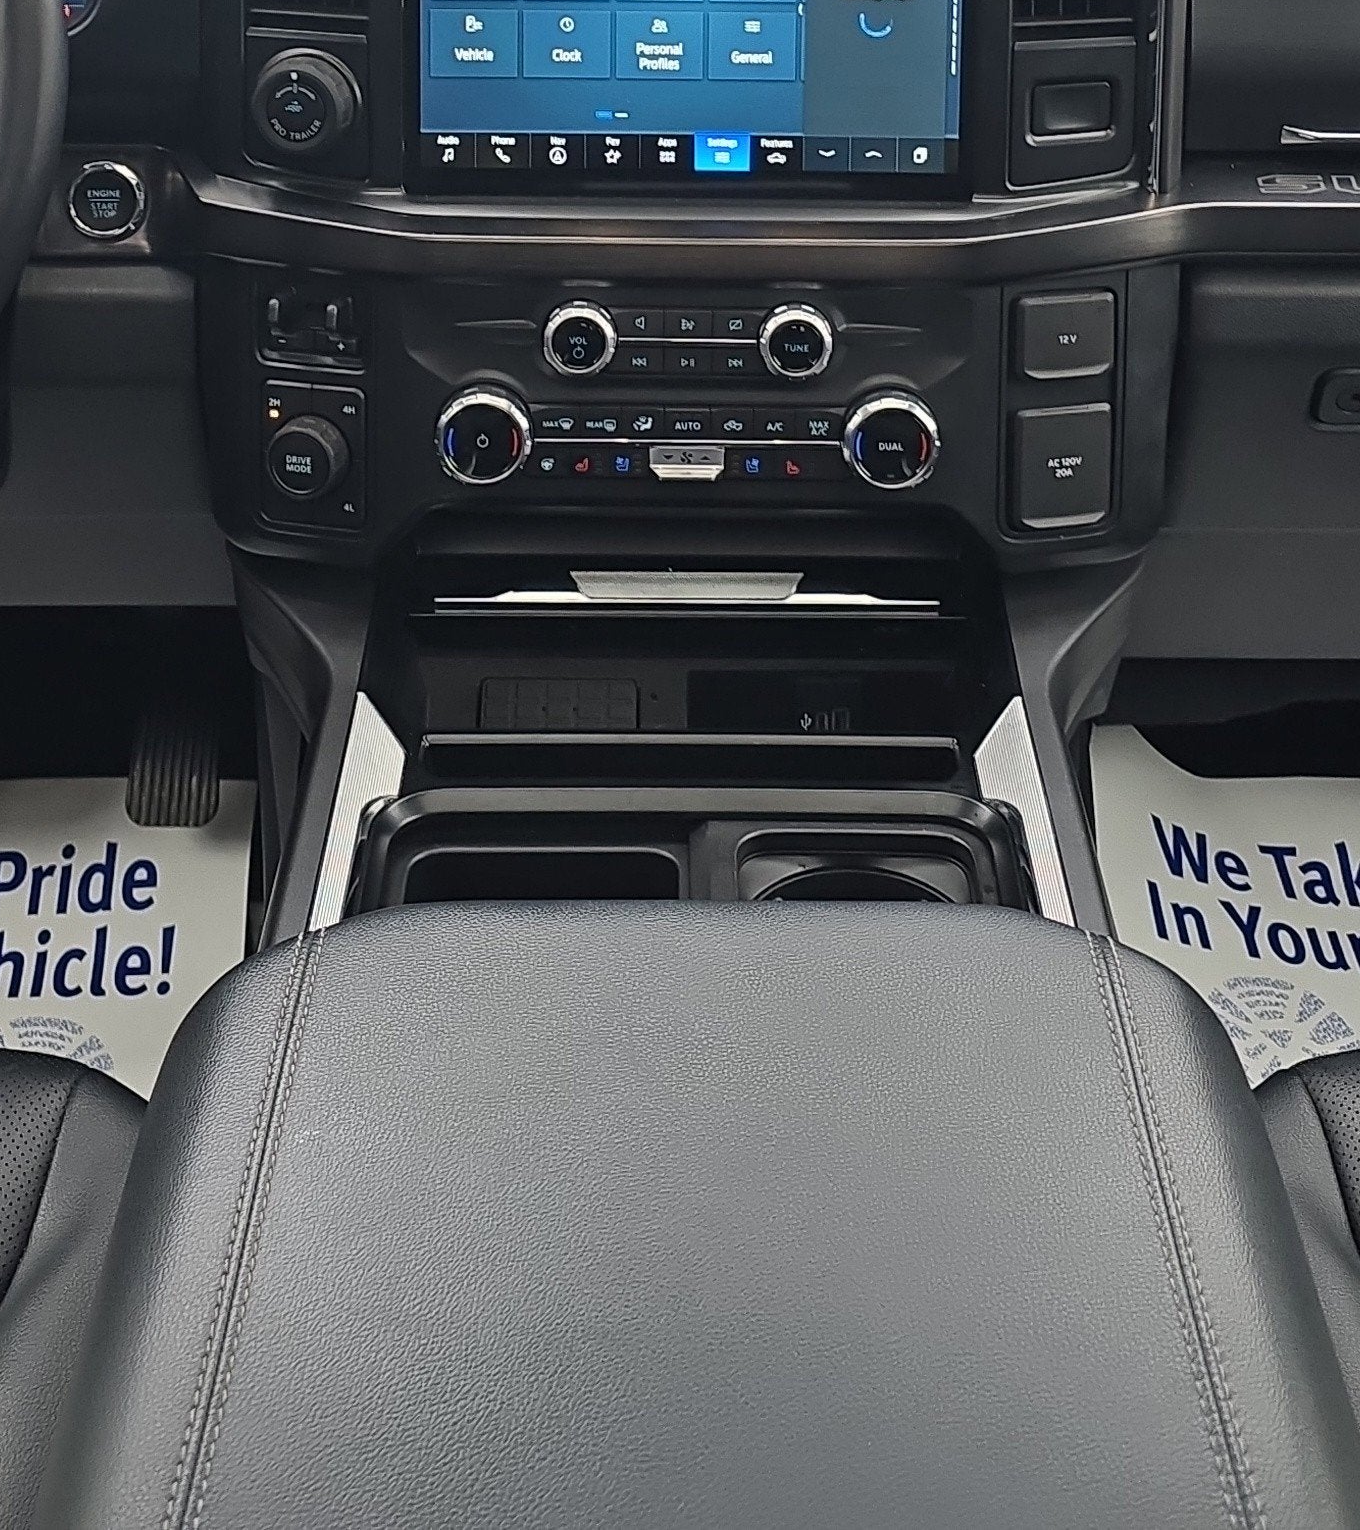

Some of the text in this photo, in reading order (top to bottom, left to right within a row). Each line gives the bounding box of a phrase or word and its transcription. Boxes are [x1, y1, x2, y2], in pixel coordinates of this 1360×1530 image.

[454, 47, 495, 62] Vehicle
[635, 42, 684, 56] Personal
[551, 48, 583, 63] Clock
[730, 50, 774, 65] General
[639, 57, 681, 71] Profiles
[270, 117, 322, 141] PRO TRAILER
[436, 135, 460, 146] Audio
[490, 135, 516, 146] Phone
[706, 138, 739, 149] Settings
[760, 138, 794, 149] Features
[87, 188, 120, 199] ENGINE
[90, 201, 118, 211] START
[92, 210, 117, 219] STOP
[568, 335, 589, 346] VOL
[1058, 335, 1070, 345] 12
[784, 342, 809, 353] TUNE
[268, 397, 281, 408] 2H
[342, 405, 356, 415] 4H
[542, 420, 559, 428] MAX
[586, 420, 606, 429] REAR
[674, 421, 701, 431] AUTO
[766, 420, 784, 432] A/C
[809, 419, 830, 429] MAX
[810, 427, 828, 437] A/C
[878, 441, 904, 453] DUAL
[285, 454, 312, 466] DRIVE
[1047, 456, 1083, 468] AC 120V
[286, 463, 312, 474] MODE
[1054, 468, 1074, 478] 20A
[343, 502, 355, 513] 4L
[1150, 812, 1252, 892] We
[1146, 879, 1213, 950] In
